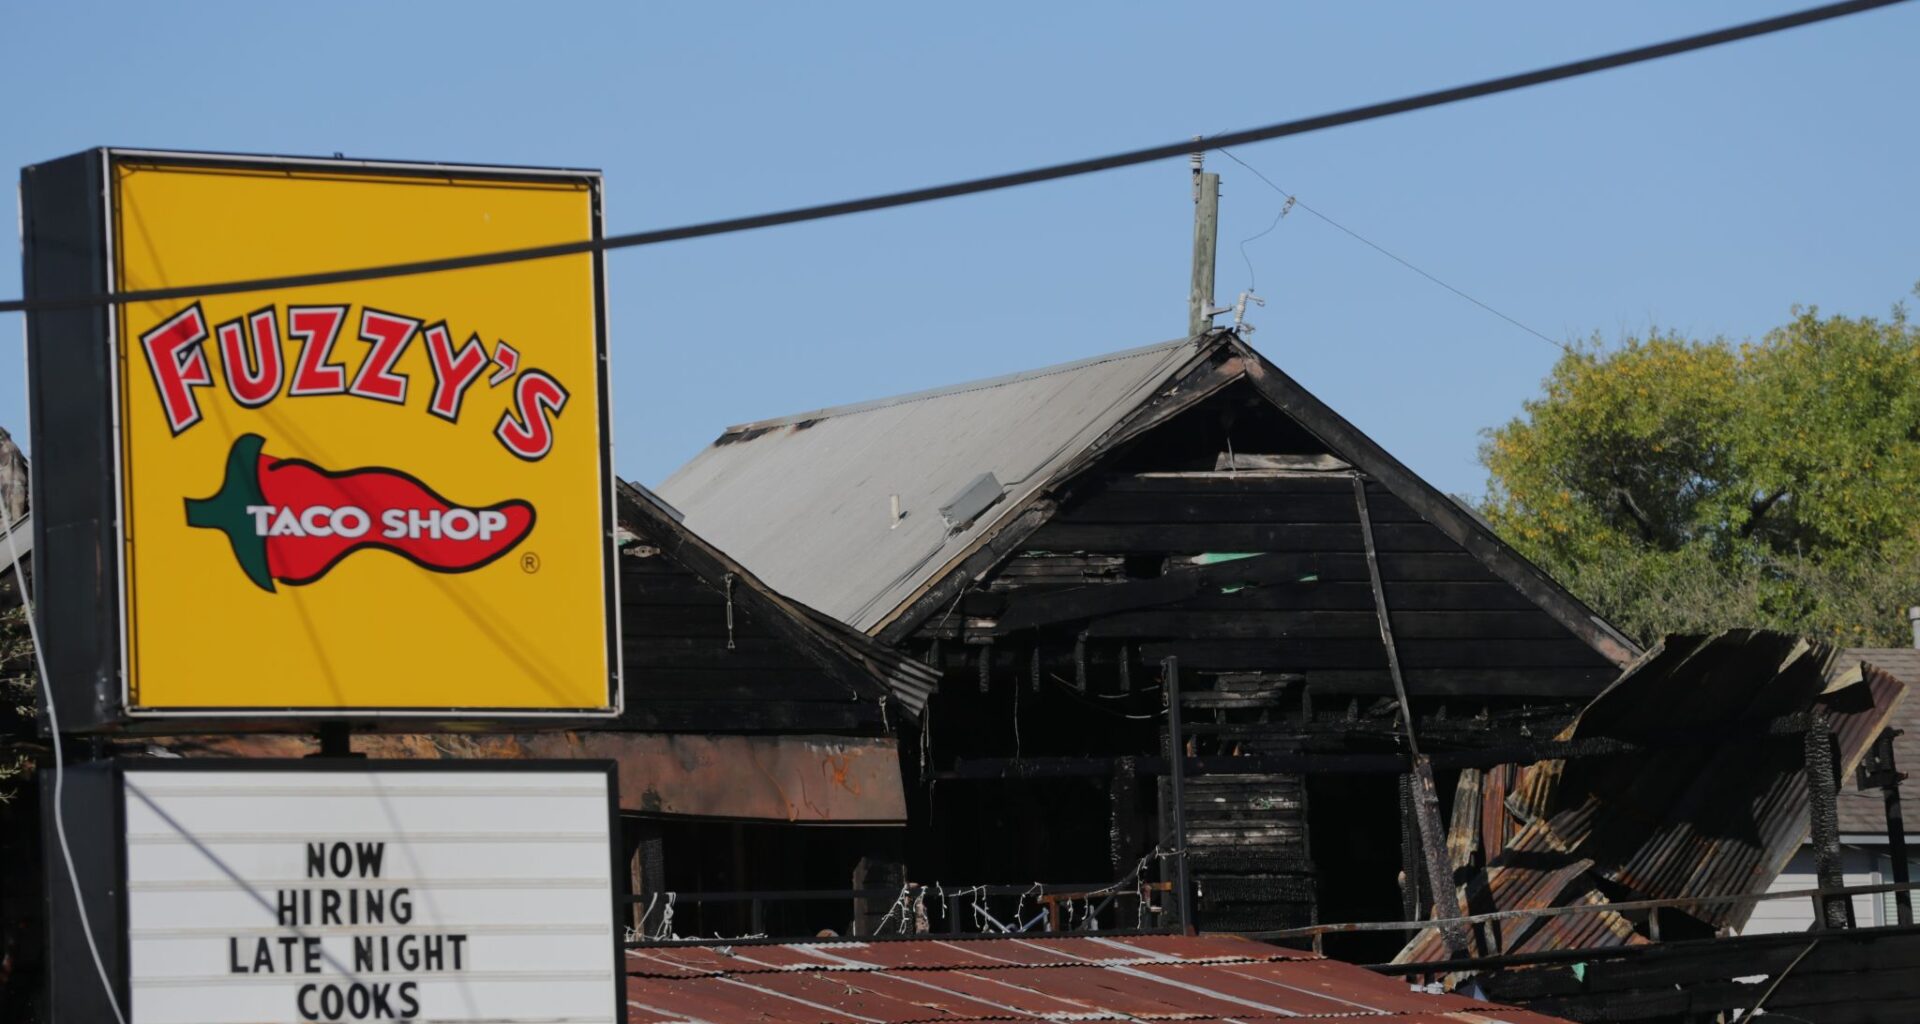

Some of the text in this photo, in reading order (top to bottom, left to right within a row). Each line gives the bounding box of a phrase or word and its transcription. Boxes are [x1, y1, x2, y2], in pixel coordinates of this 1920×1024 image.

[139, 302, 570, 462] FUZZY'S
[247, 506, 508, 541] TACO SHOP
[307, 842, 385, 878] NOW
[277, 888, 413, 926] HIRING
[229, 935, 467, 973] LATE NIGHT
[298, 982, 419, 1020] COOKS
